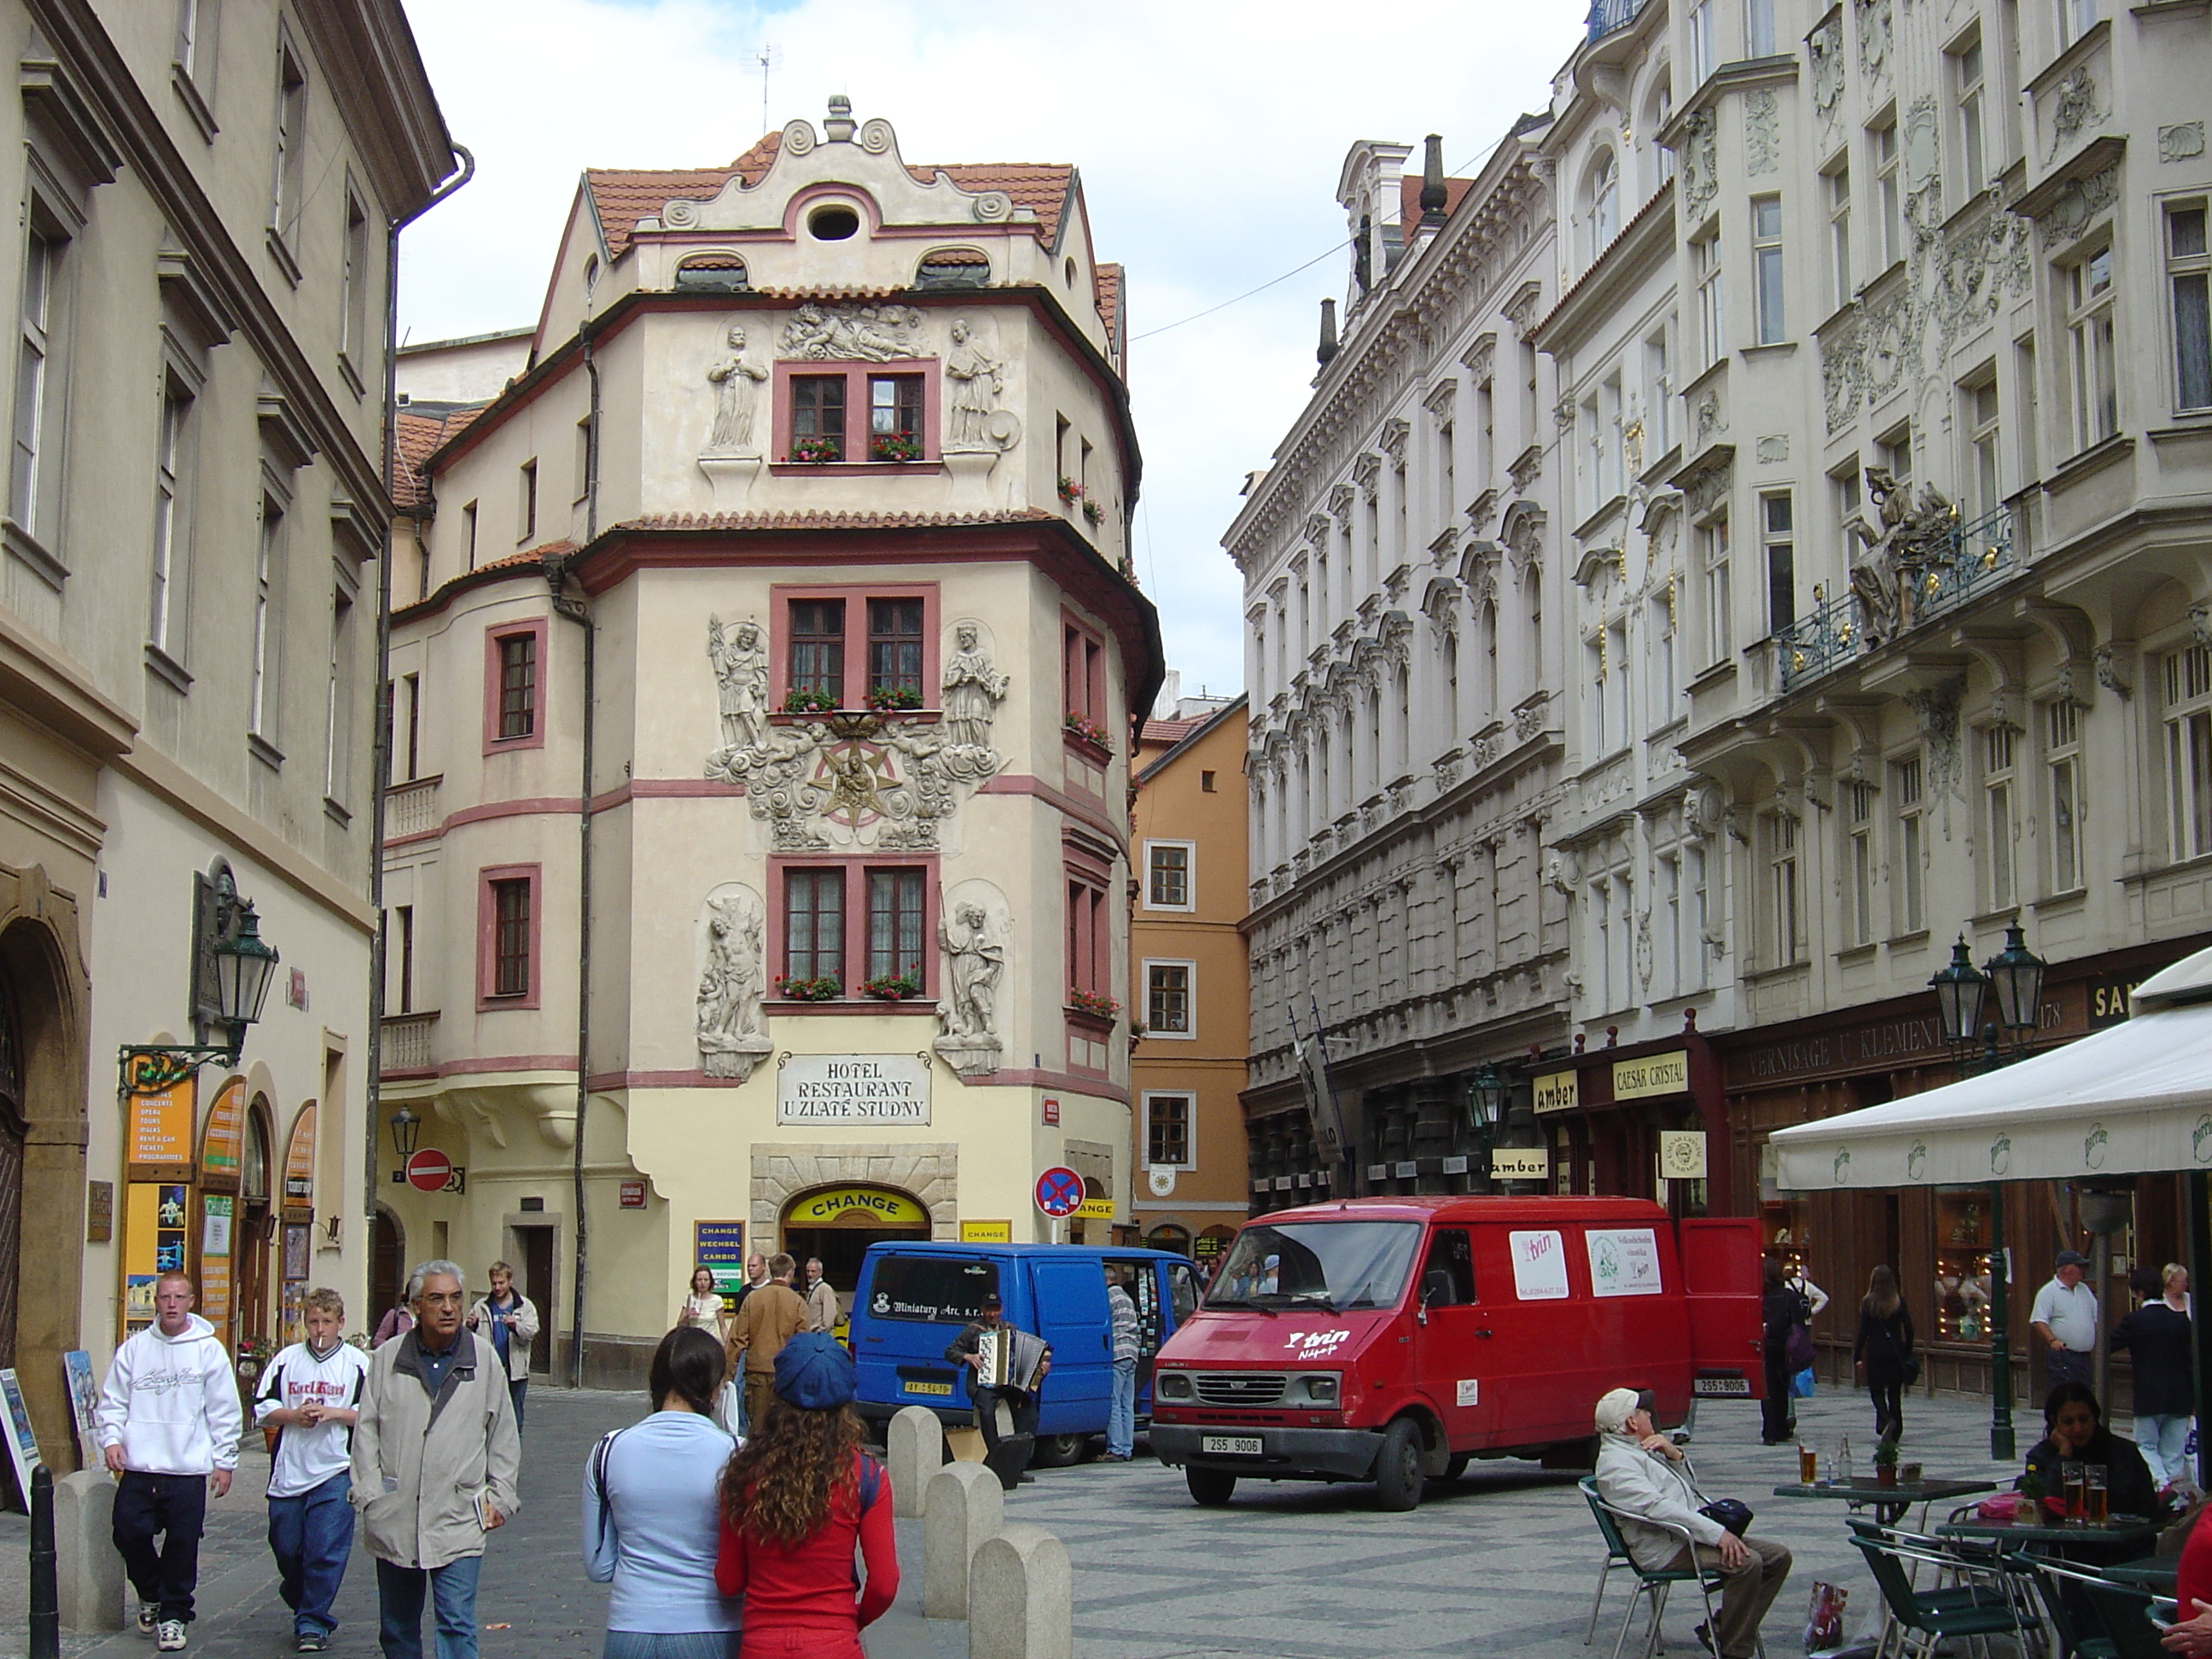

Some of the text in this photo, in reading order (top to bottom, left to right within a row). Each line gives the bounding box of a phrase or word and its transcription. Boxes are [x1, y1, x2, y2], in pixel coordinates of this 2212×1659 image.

[1749, 1038, 1831, 1076] VERNISAGE
[1840, 1033, 1851, 1062] U
[1861, 1017, 1944, 1058] KLEMENT
[827, 1062, 882, 1079] HOTEL
[1616, 1062, 1685, 1091] CAESAR CRYSTAL
[797, 1080, 912, 1098] RESTAURANT
[1538, 1075, 1575, 1109] amber
[784, 1097, 924, 1117] U ZLATÉ STUDNY
[138, 1153, 183, 1161] PROGRAMMES
[1491, 1159, 1545, 1173] amber
[206, 1199, 233, 1215] CHANGE
[812, 1194, 900, 1216] CHANGE
[1079, 1204, 1113, 1214] ANGE
[893, 1301, 938, 1316] Miniatury
[288, 1381, 316, 1395] Karl
[1702, 1380, 1746, 1392] 2S5 9006
[1210, 1438, 1259, 1452] 2S5 9006
